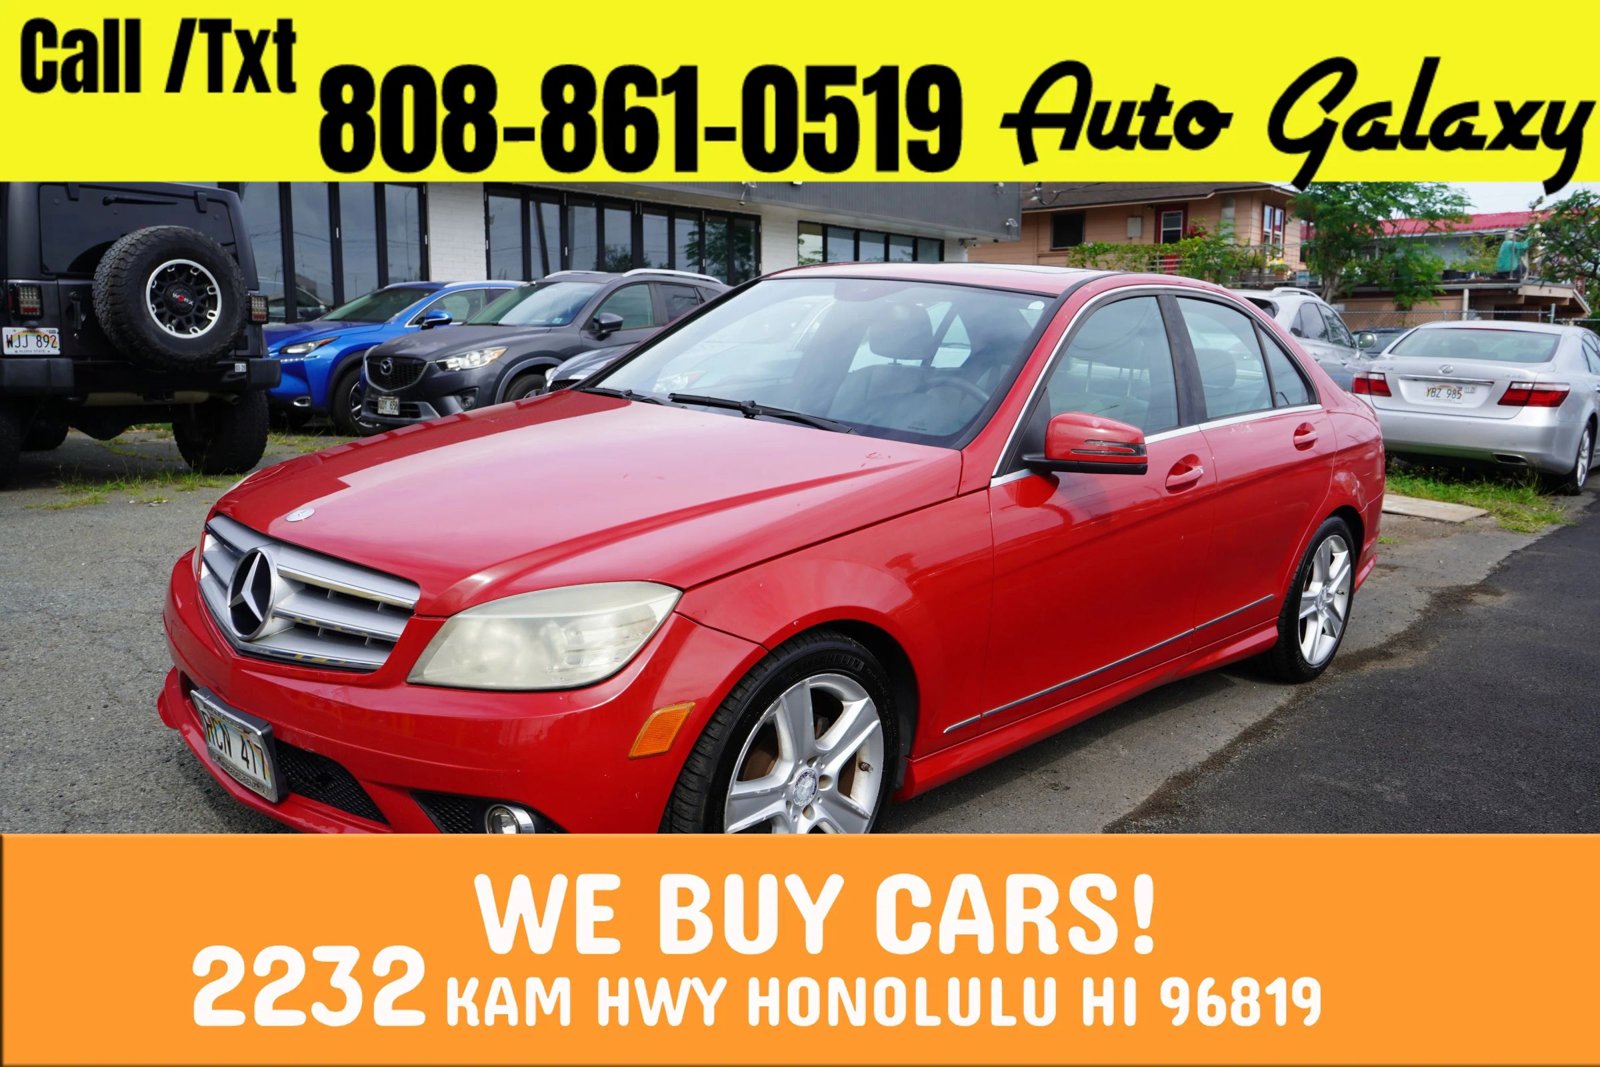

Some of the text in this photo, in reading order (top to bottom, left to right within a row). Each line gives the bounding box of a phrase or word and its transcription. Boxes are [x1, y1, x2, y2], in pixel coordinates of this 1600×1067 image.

[6, 334, 58, 348] WJJ 892
[1446, 388, 1463, 399] 985
